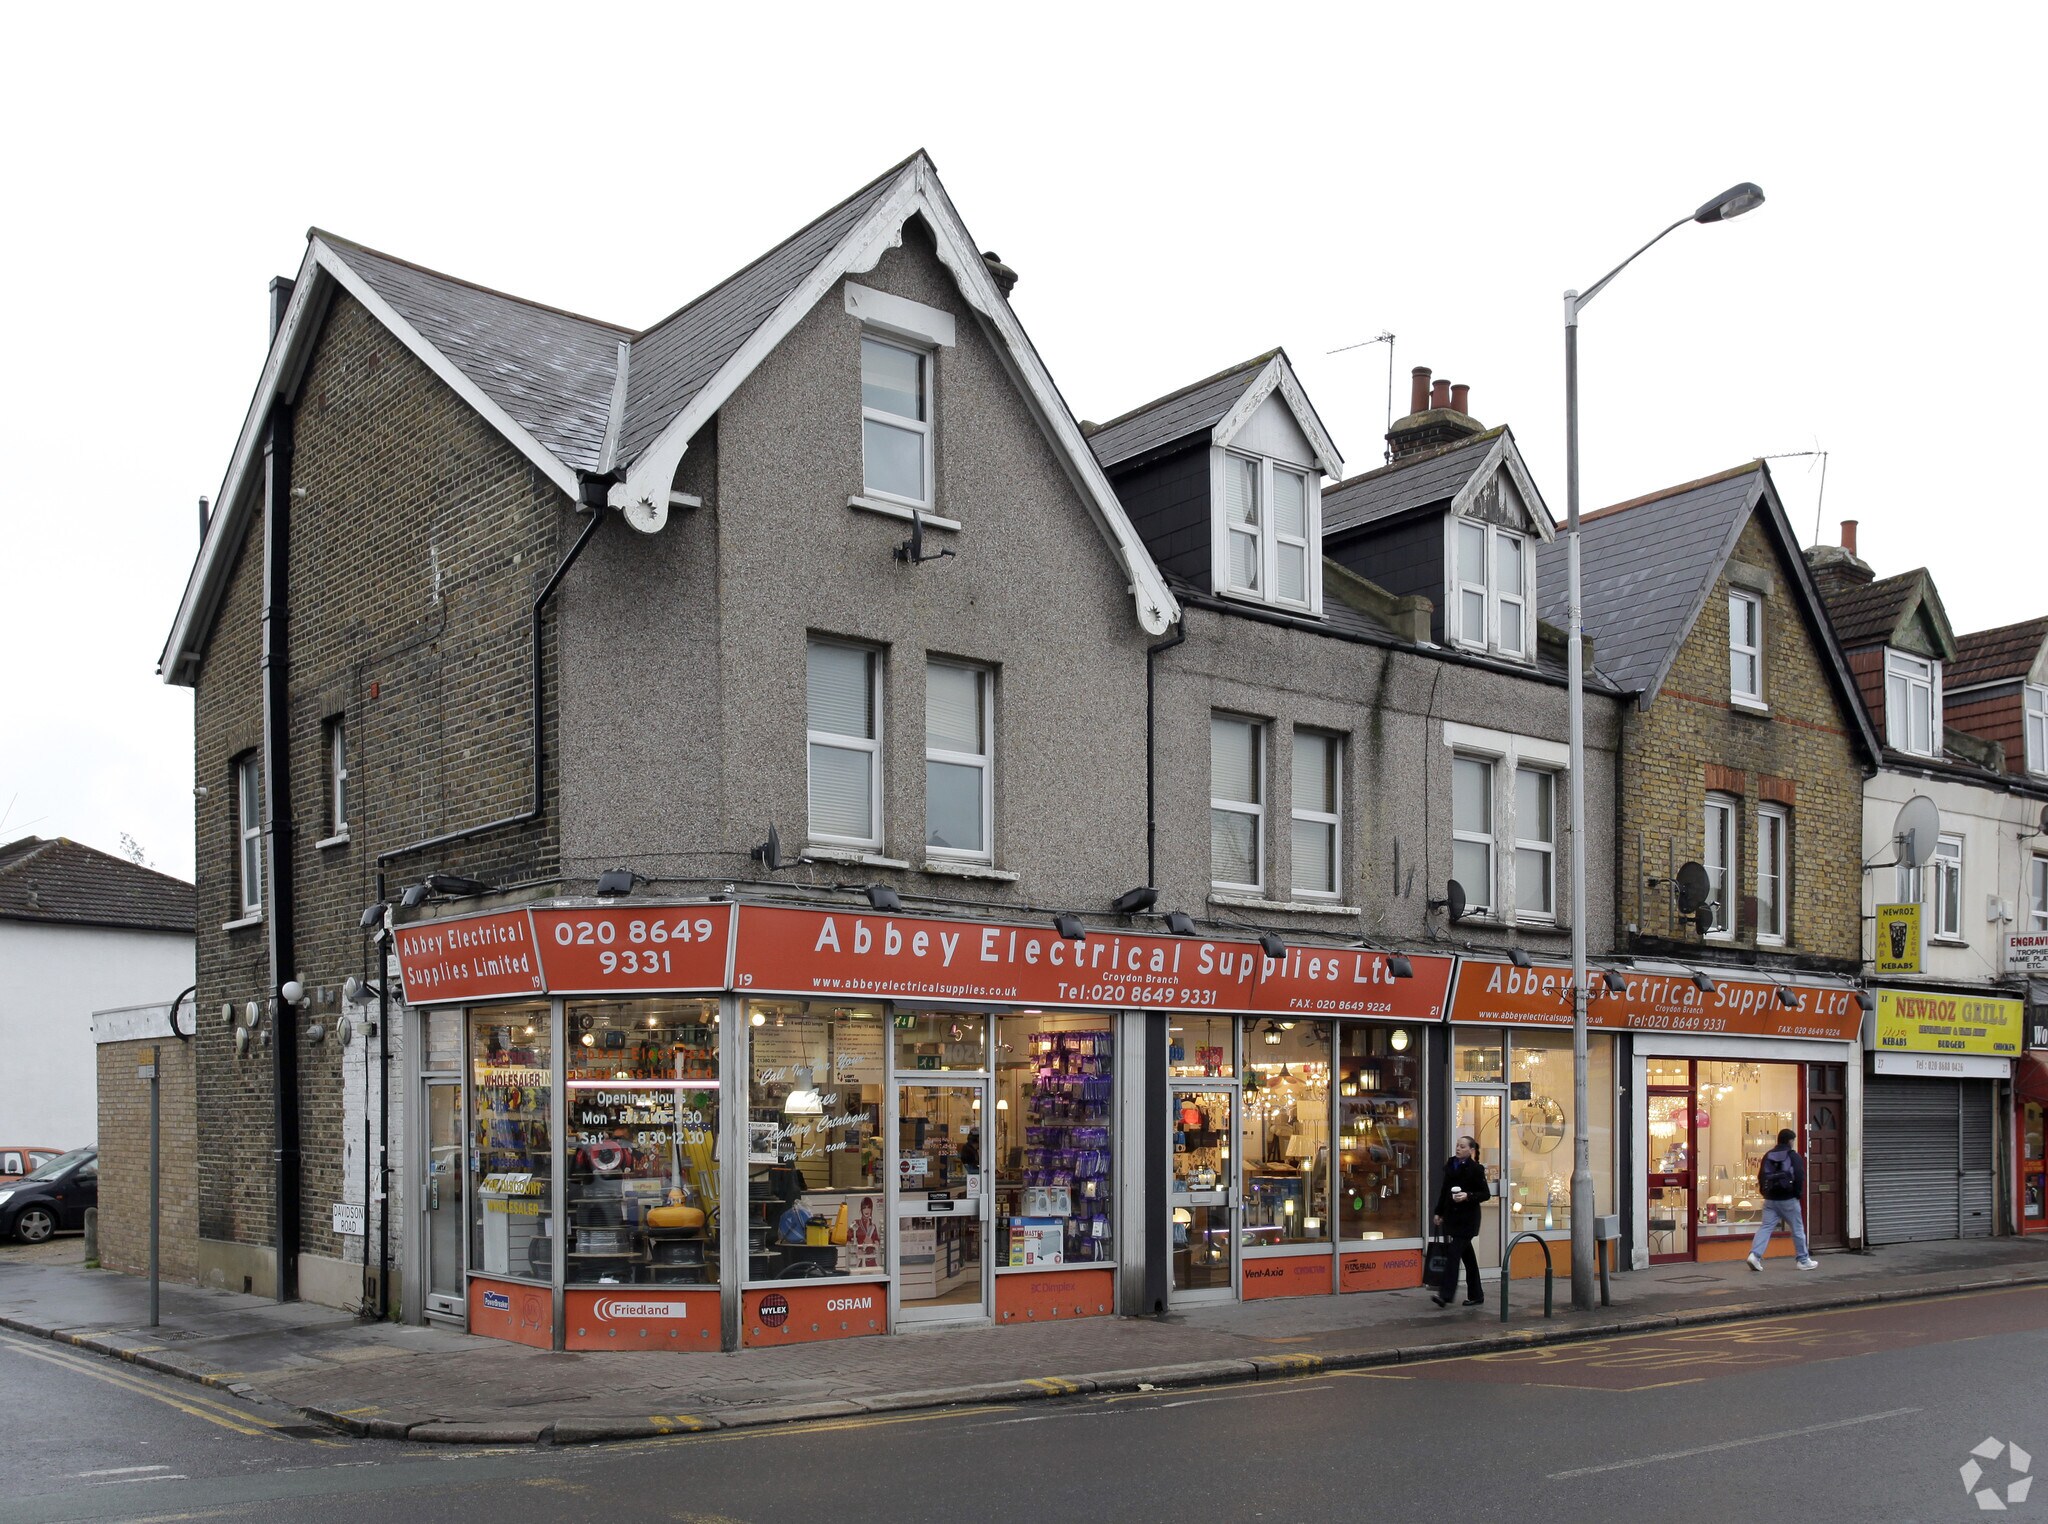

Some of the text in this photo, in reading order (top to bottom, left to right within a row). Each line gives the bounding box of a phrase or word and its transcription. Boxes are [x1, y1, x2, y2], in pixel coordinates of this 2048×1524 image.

[1882, 907, 1914, 916] NEWROZ
[403, 920, 524, 956] Abbey Electrical
[554, 918, 713, 946] 020 8649
[814, 916, 960, 967] Abbey
[980, 927, 1181, 974] Electrical
[1197, 943, 1340, 985] Supplies
[599, 949, 672, 975] 9331
[1881, 962, 1913, 970] KEBABS
[407, 952, 530, 988] Supplies Limited
[531, 975, 541, 988] 19
[737, 973, 753, 987] 19
[1102, 971, 1179, 985] Croydon Branch
[812, 976, 1018, 998] www.abbeyelectricalsupplies.co.uk
[1486, 965, 1574, 1005] Abbey
[1814, 990, 1850, 1016] Ltd
[1131, 987, 1175, 1004] 8649
[1180, 989, 1218, 1006] 9331
[1289, 998, 1392, 1013] FAX: 020 8649 9224
[1429, 1006, 1440, 1016] 21
[1654, 1004, 1704, 1014] Croydon Branch
[1895, 996, 1957, 1022] NEWROZ
[1961, 1002, 2008, 1026] GRILL
[1672, 1016, 1700, 1029] 8649
[1703, 1018, 1727, 1031] 9331
[1794, 1026, 1806, 1034] 020
[1807, 1027, 1824, 1035] 8649
[1825, 1028, 1841, 1036] 9224
[1882, 1037, 1907, 1047] KEBABS
[484, 1072, 541, 1087] WHOLESALER
[760, 1066, 787, 1086] Call
[597, 1091, 647, 1107] Opening
[582, 1111, 608, 1125] Mon
[816, 1111, 870, 1133] Catalogue
[581, 1131, 604, 1145] Sat
[783, 1152, 798, 1162] on
[333, 1205, 364, 1219] DAVIDSON
[487, 1199, 539, 1216] WHOLESALER
[340, 1219, 357, 1233] ROAD
[1244, 1266, 1284, 1279] Vent-Axia
[614, 1304, 669, 1315] Friedland
[761, 1296, 872, 1315] WYLEX OSRAM
